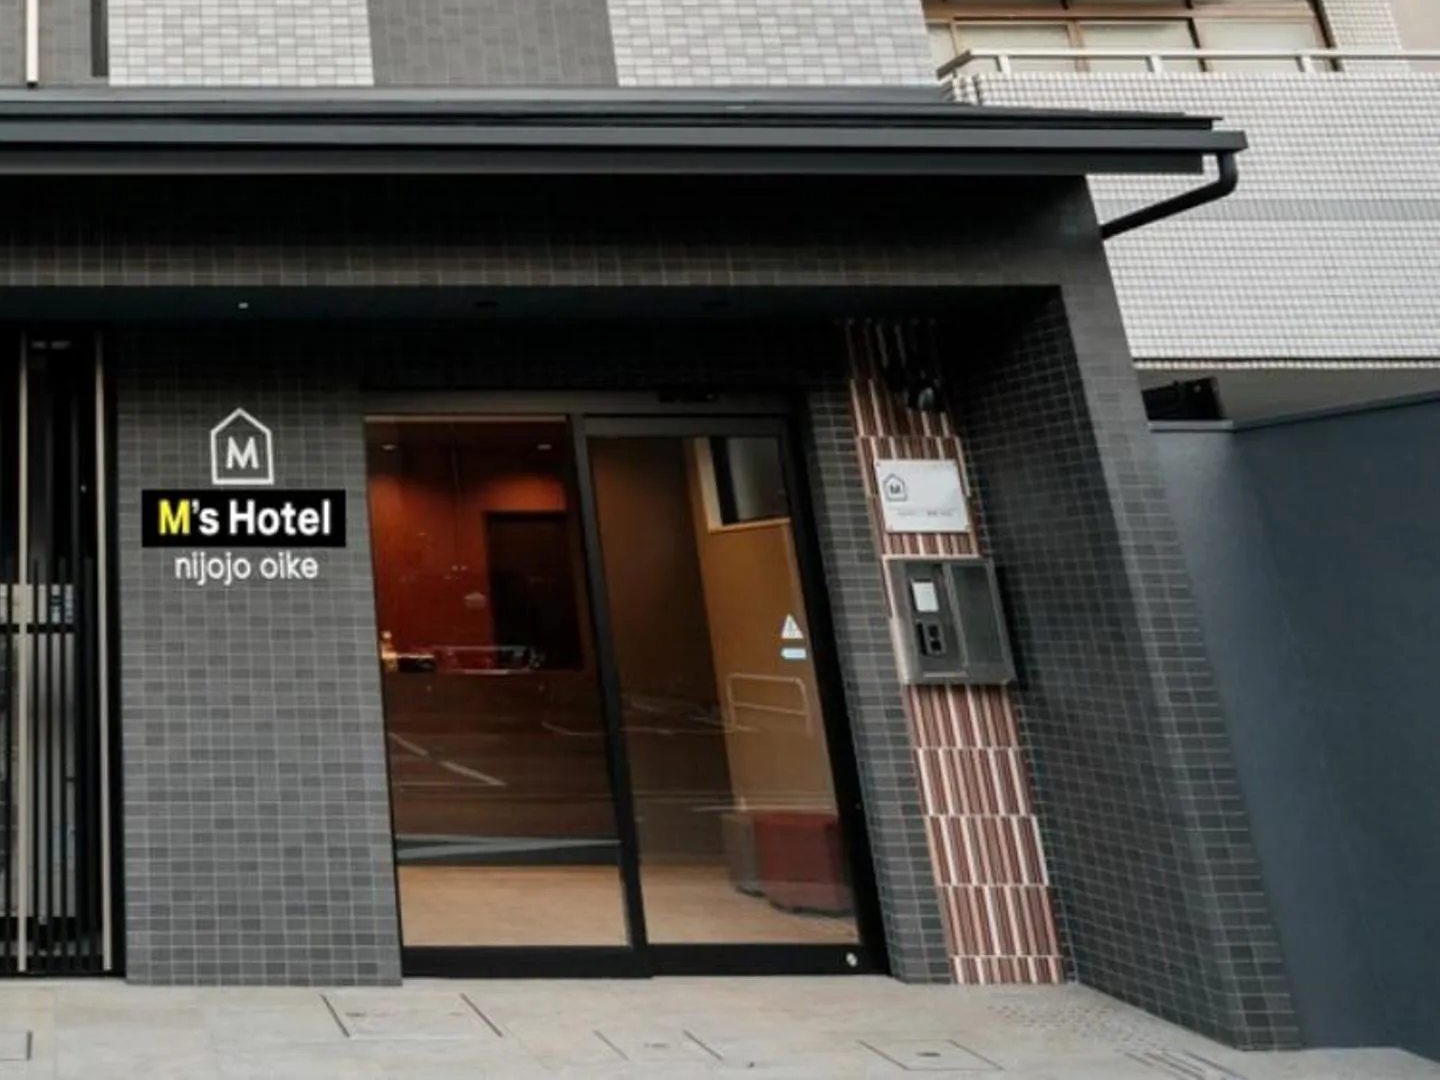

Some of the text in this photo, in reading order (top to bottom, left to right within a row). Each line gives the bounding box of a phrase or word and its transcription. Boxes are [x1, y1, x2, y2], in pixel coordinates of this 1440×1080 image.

[226, 437, 259, 469] M
[158, 499, 331, 536] M's Hotel
[174, 551, 319, 586] nijojo oike
